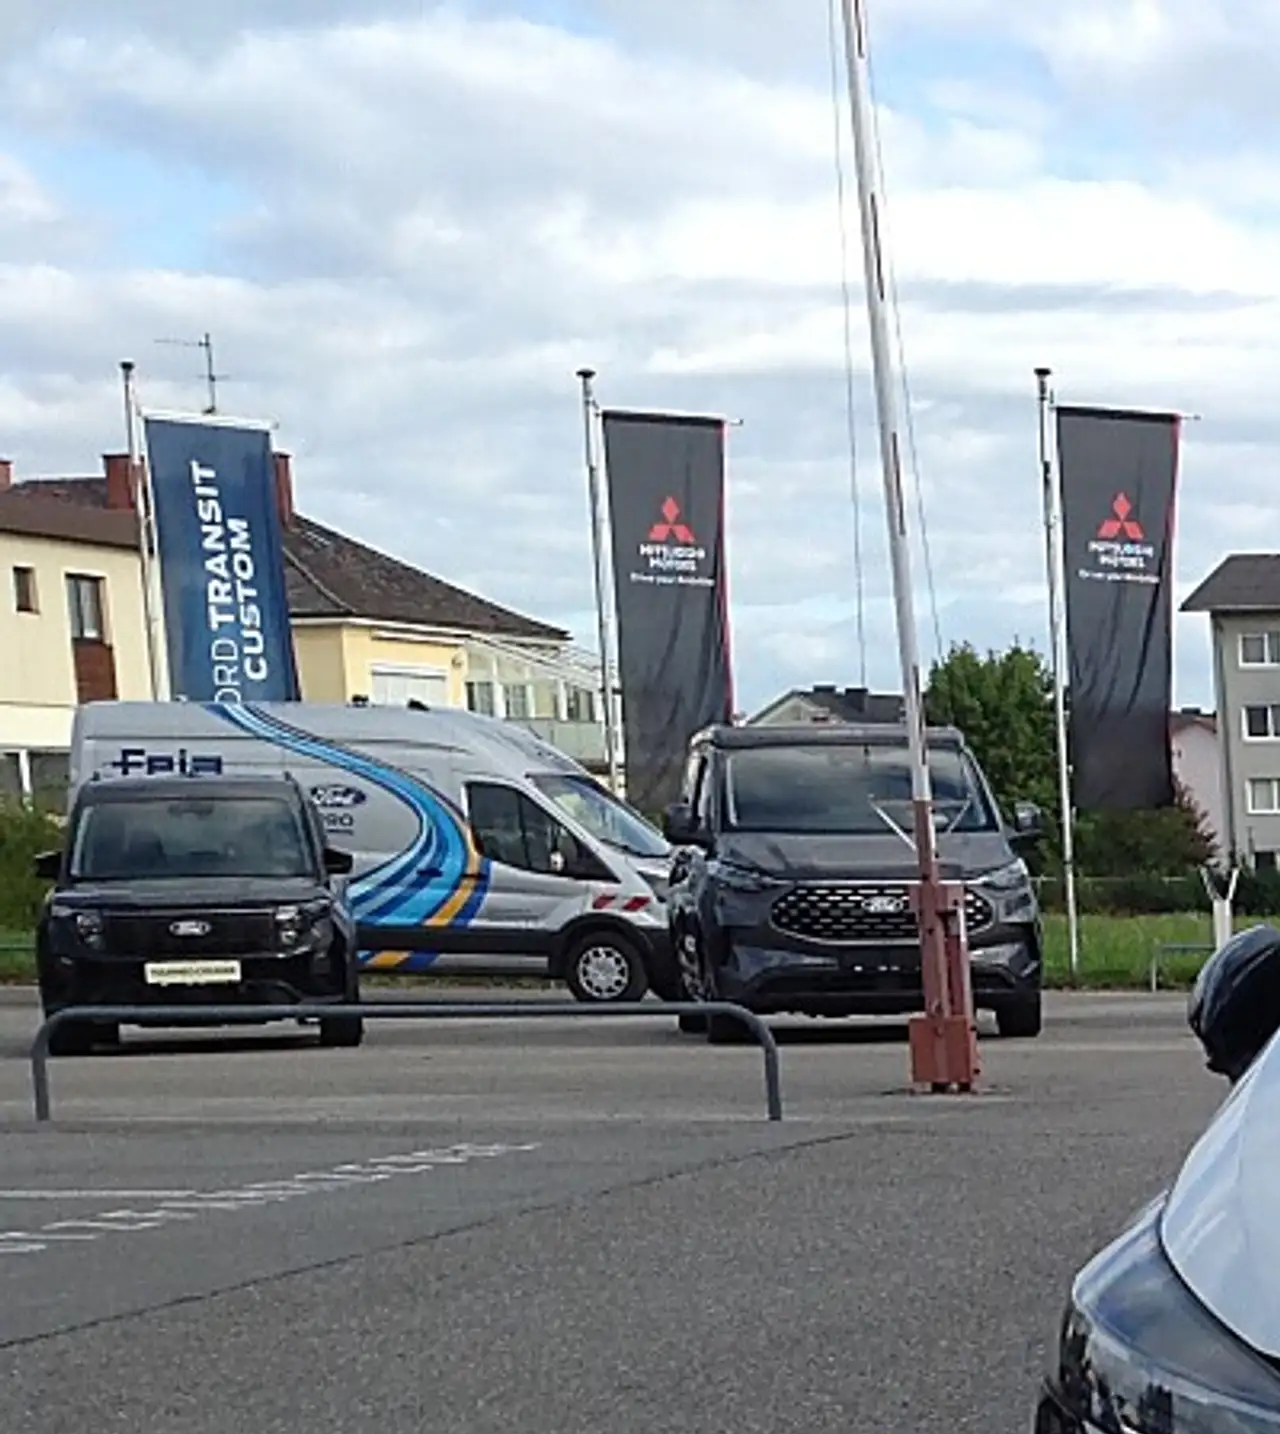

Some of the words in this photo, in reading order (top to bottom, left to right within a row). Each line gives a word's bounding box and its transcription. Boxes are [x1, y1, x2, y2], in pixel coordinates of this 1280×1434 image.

[190, 459, 235, 631] TRANSIT
[227, 517, 268, 681] CUSTOM
[212, 637, 242, 702] ORD
